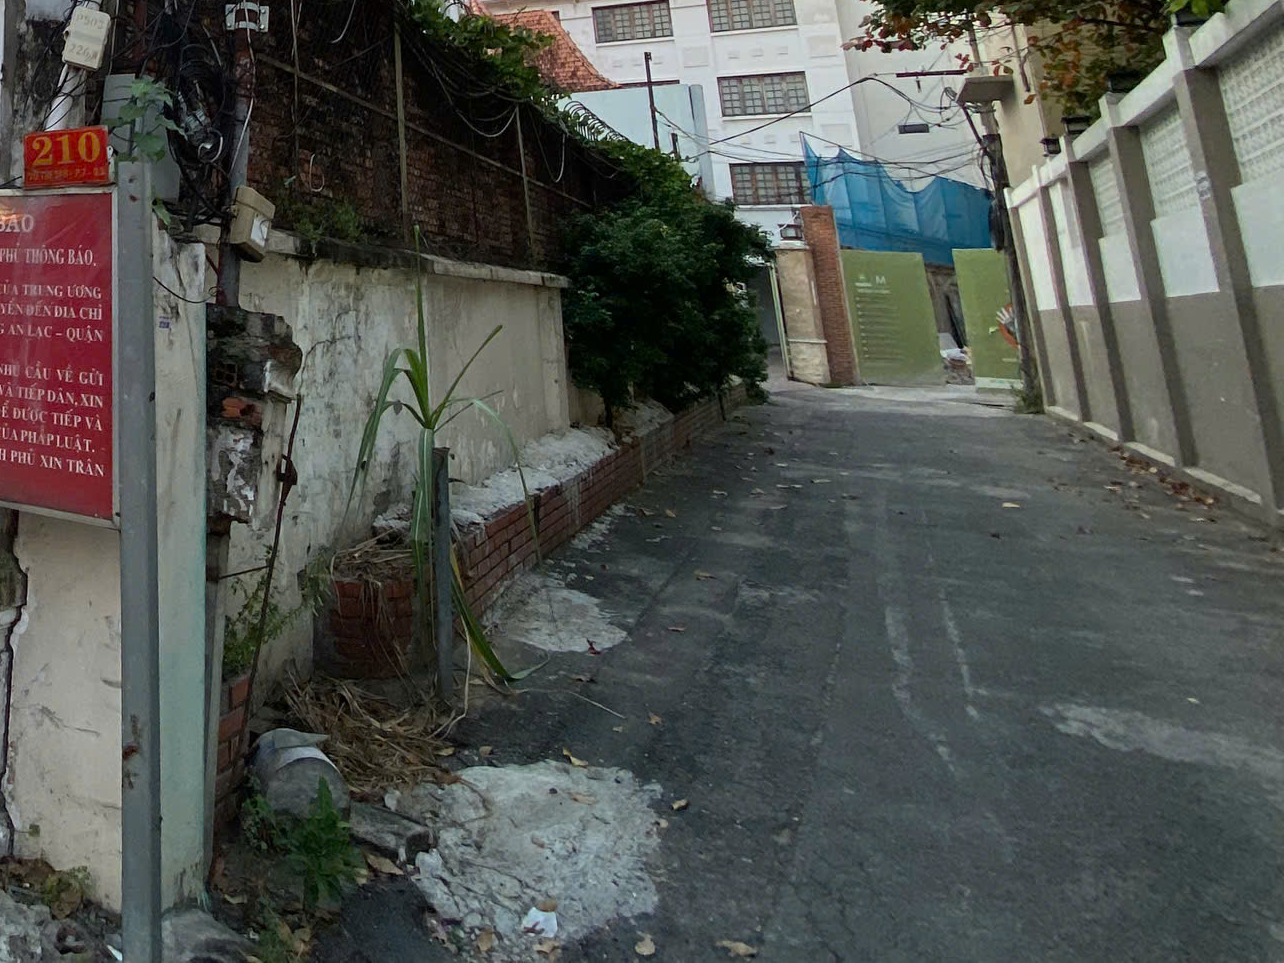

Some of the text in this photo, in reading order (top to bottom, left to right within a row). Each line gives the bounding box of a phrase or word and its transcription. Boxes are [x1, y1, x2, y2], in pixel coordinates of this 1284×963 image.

[32, 132, 101, 166] 210
[25, 244, 64, 265] THÔNG
[8, 324, 24, 335] AN
[66, 325, 103, 343] QUẬN
[80, 393, 104, 408] XIN
[85, 414, 103, 431] VÀ
[39, 454, 63, 470] XIN
